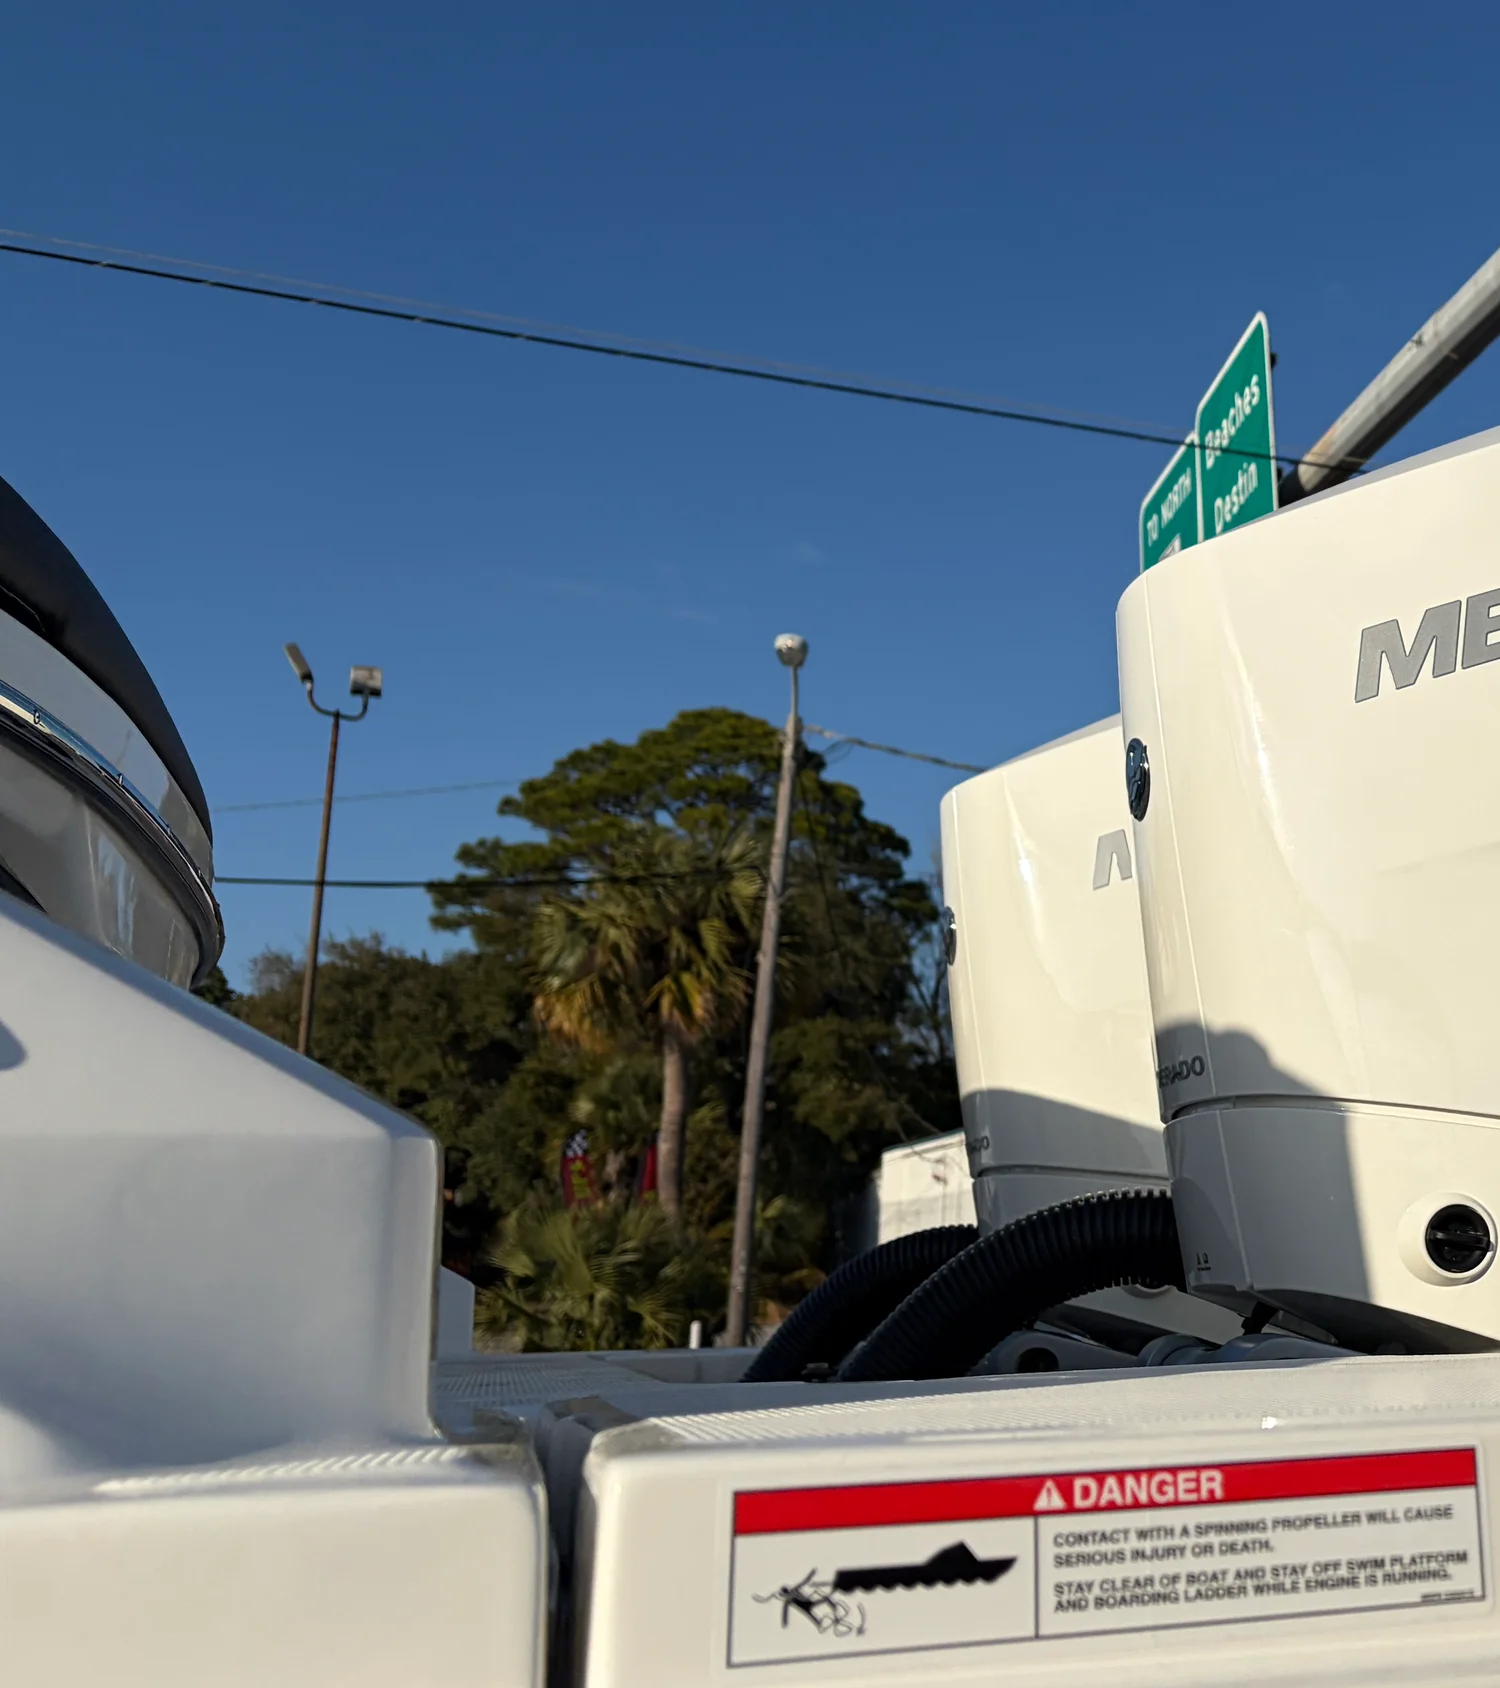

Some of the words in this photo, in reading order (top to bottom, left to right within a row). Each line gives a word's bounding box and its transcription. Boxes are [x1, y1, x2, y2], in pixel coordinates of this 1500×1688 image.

[1204, 374, 1260, 470] Beaches
[1147, 513, 1159, 546] TO
[1161, 467, 1192, 529] NORTH
[1214, 461, 1258, 535] Destin
[1073, 1469, 1225, 1508] DANGER
[1054, 1527, 1130, 1548] CONTACT
[1136, 1524, 1175, 1542] WITH
[1179, 1523, 1190, 1539] A
[1195, 1517, 1268, 1538] SPINNING
[1272, 1511, 1361, 1532] PROPELLER
[1366, 1508, 1400, 1526] WILL
[1404, 1504, 1453, 1523] CAUSE
[1054, 1548, 1126, 1569] SERIOUS
[1131, 1544, 1186, 1563] INJURY
[1191, 1542, 1214, 1559] OR
[1054, 1580, 1094, 1597] STAY
[1099, 1575, 1155, 1594] CLEAR
[1159, 1573, 1182, 1589] OF
[1186, 1569, 1229, 1587] BOAT
[1233, 1566, 1266, 1583] AND
[1271, 1563, 1308, 1580] STAY
[1313, 1561, 1342, 1577] OFF
[1346, 1557, 1386, 1575] SWIM
[1390, 1551, 1467, 1571] PLATFORM
[1054, 1597, 1089, 1613] AND
[1094, 1590, 1179, 1610] BOARDING
[1184, 1584, 1248, 1603] LADDER
[1253, 1580, 1300, 1598] WHILE
[1305, 1575, 1360, 1594] ENGINE
[1364, 1574, 1378, 1589] IS
